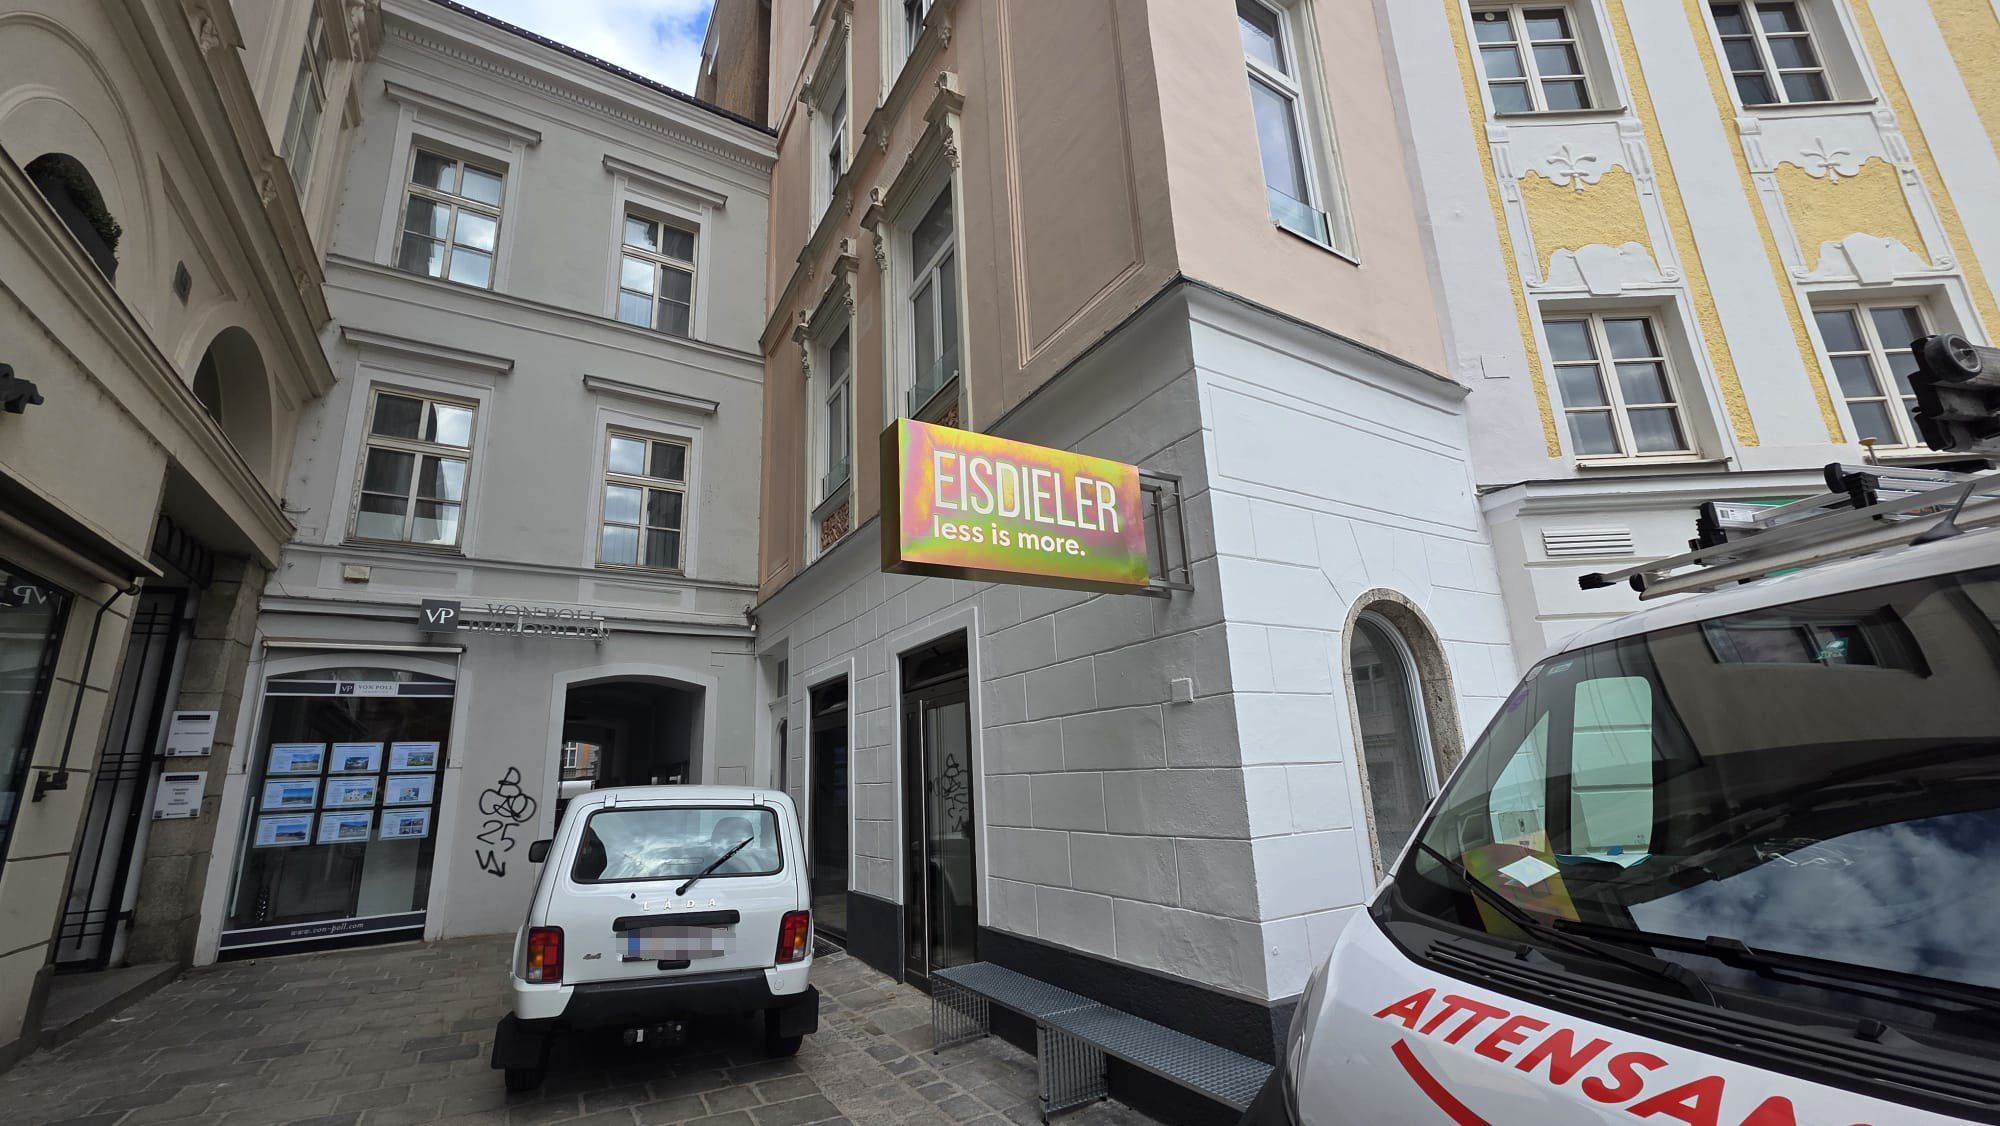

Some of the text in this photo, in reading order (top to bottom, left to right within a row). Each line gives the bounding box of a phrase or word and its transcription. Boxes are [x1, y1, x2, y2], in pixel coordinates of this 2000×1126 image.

[933, 450, 1120, 533] EISDIELER
[933, 514, 1086, 557] less is more.
[425, 607, 454, 624] VP
[488, 603, 537, 618] VON
[642, 898, 717, 912] LADA
